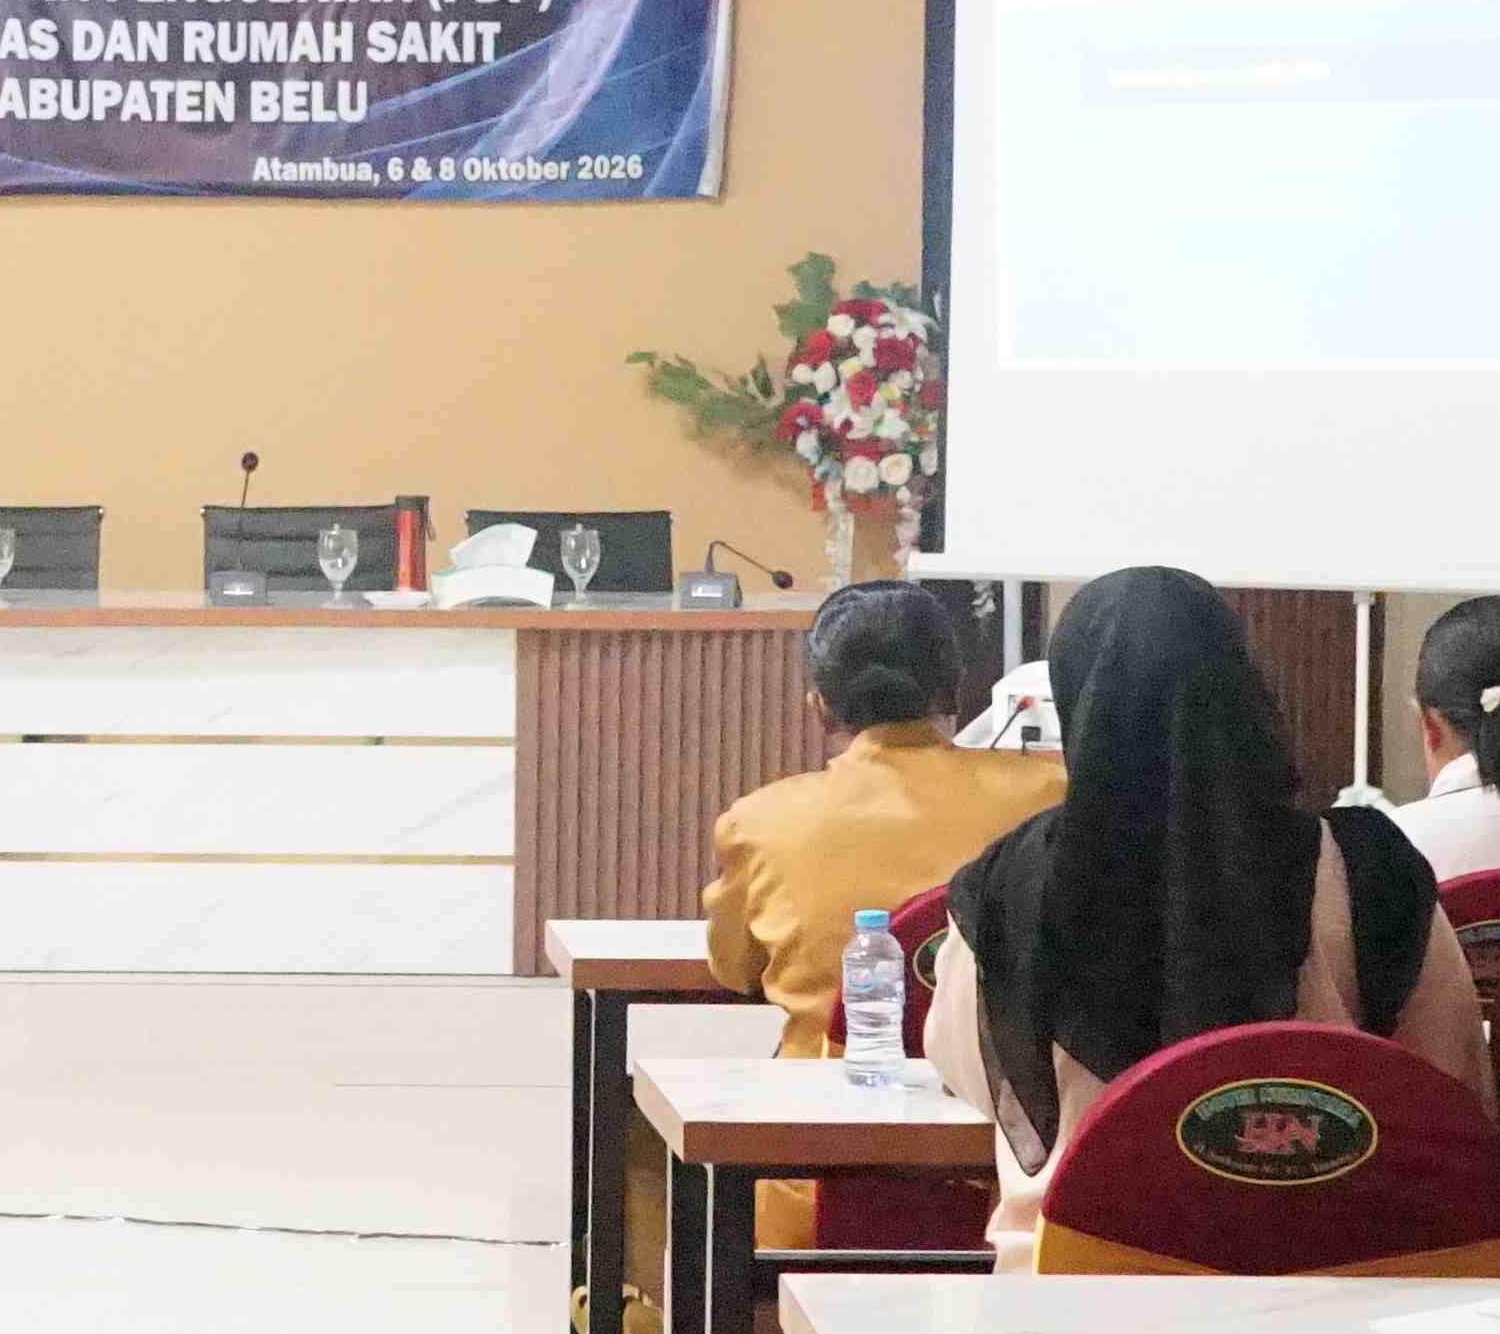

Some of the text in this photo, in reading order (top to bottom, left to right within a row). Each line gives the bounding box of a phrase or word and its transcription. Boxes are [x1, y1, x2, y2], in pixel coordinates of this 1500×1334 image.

[72, 21, 172, 62] DAN
[182, 22, 352, 62] RUMAH
[366, 21, 501, 63] SAKIT
[251, 80, 368, 124] BELU
[252, 155, 643, 186] Atambua, 6 & 8 Oktober 2026
